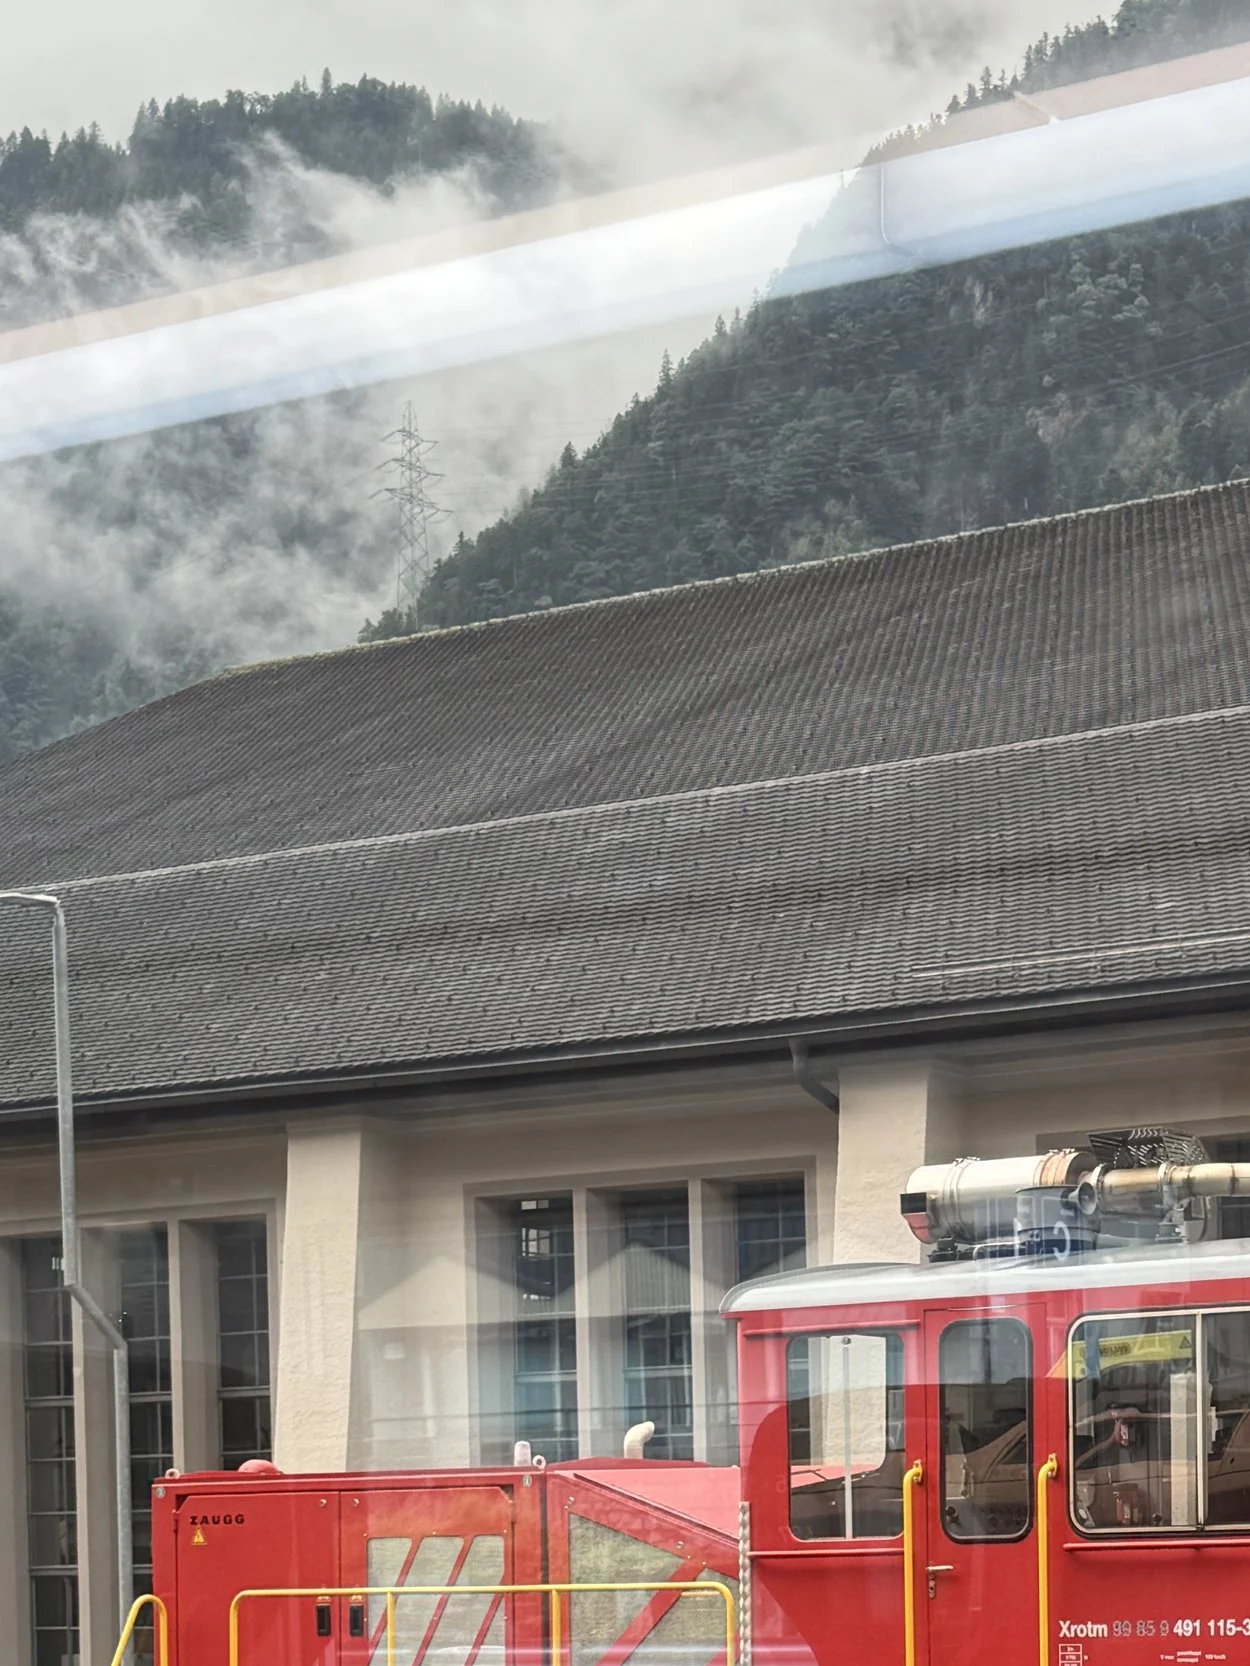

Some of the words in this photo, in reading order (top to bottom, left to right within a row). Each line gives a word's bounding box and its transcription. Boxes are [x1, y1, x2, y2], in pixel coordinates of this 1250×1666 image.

[190, 1514, 245, 1525] ZAUGG
[1059, 1620, 1108, 1637] Xrotm
[1112, 1620, 1131, 1636] 99
[1136, 1620, 1155, 1636] 85
[1173, 1619, 1201, 1637] 491
